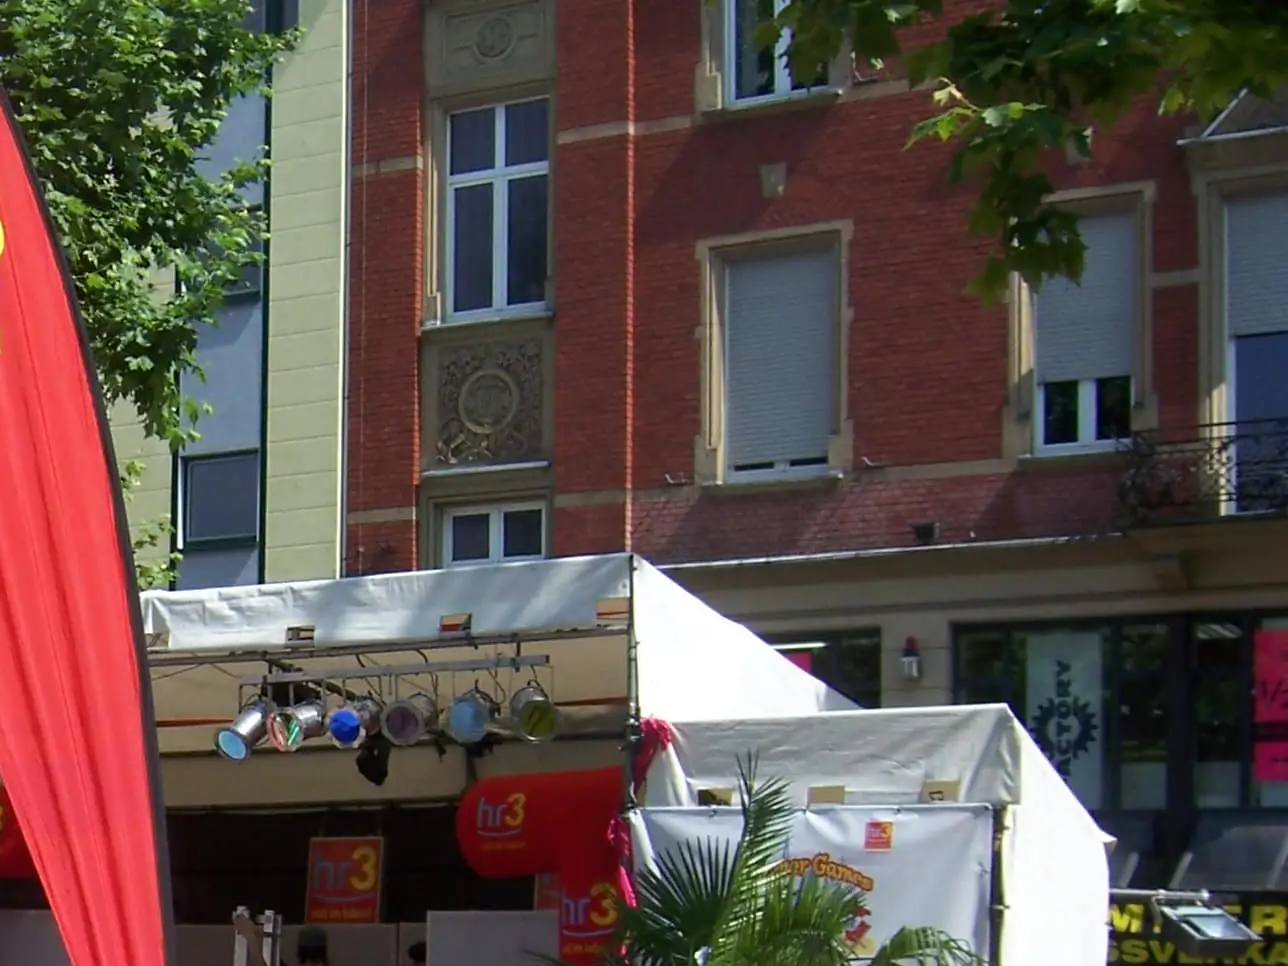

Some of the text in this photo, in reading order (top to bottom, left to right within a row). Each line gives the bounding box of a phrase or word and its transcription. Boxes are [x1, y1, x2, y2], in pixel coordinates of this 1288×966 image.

[476, 793, 526, 828] hr3
[314, 845, 377, 891] hr3
[561, 883, 618, 925] hr3
